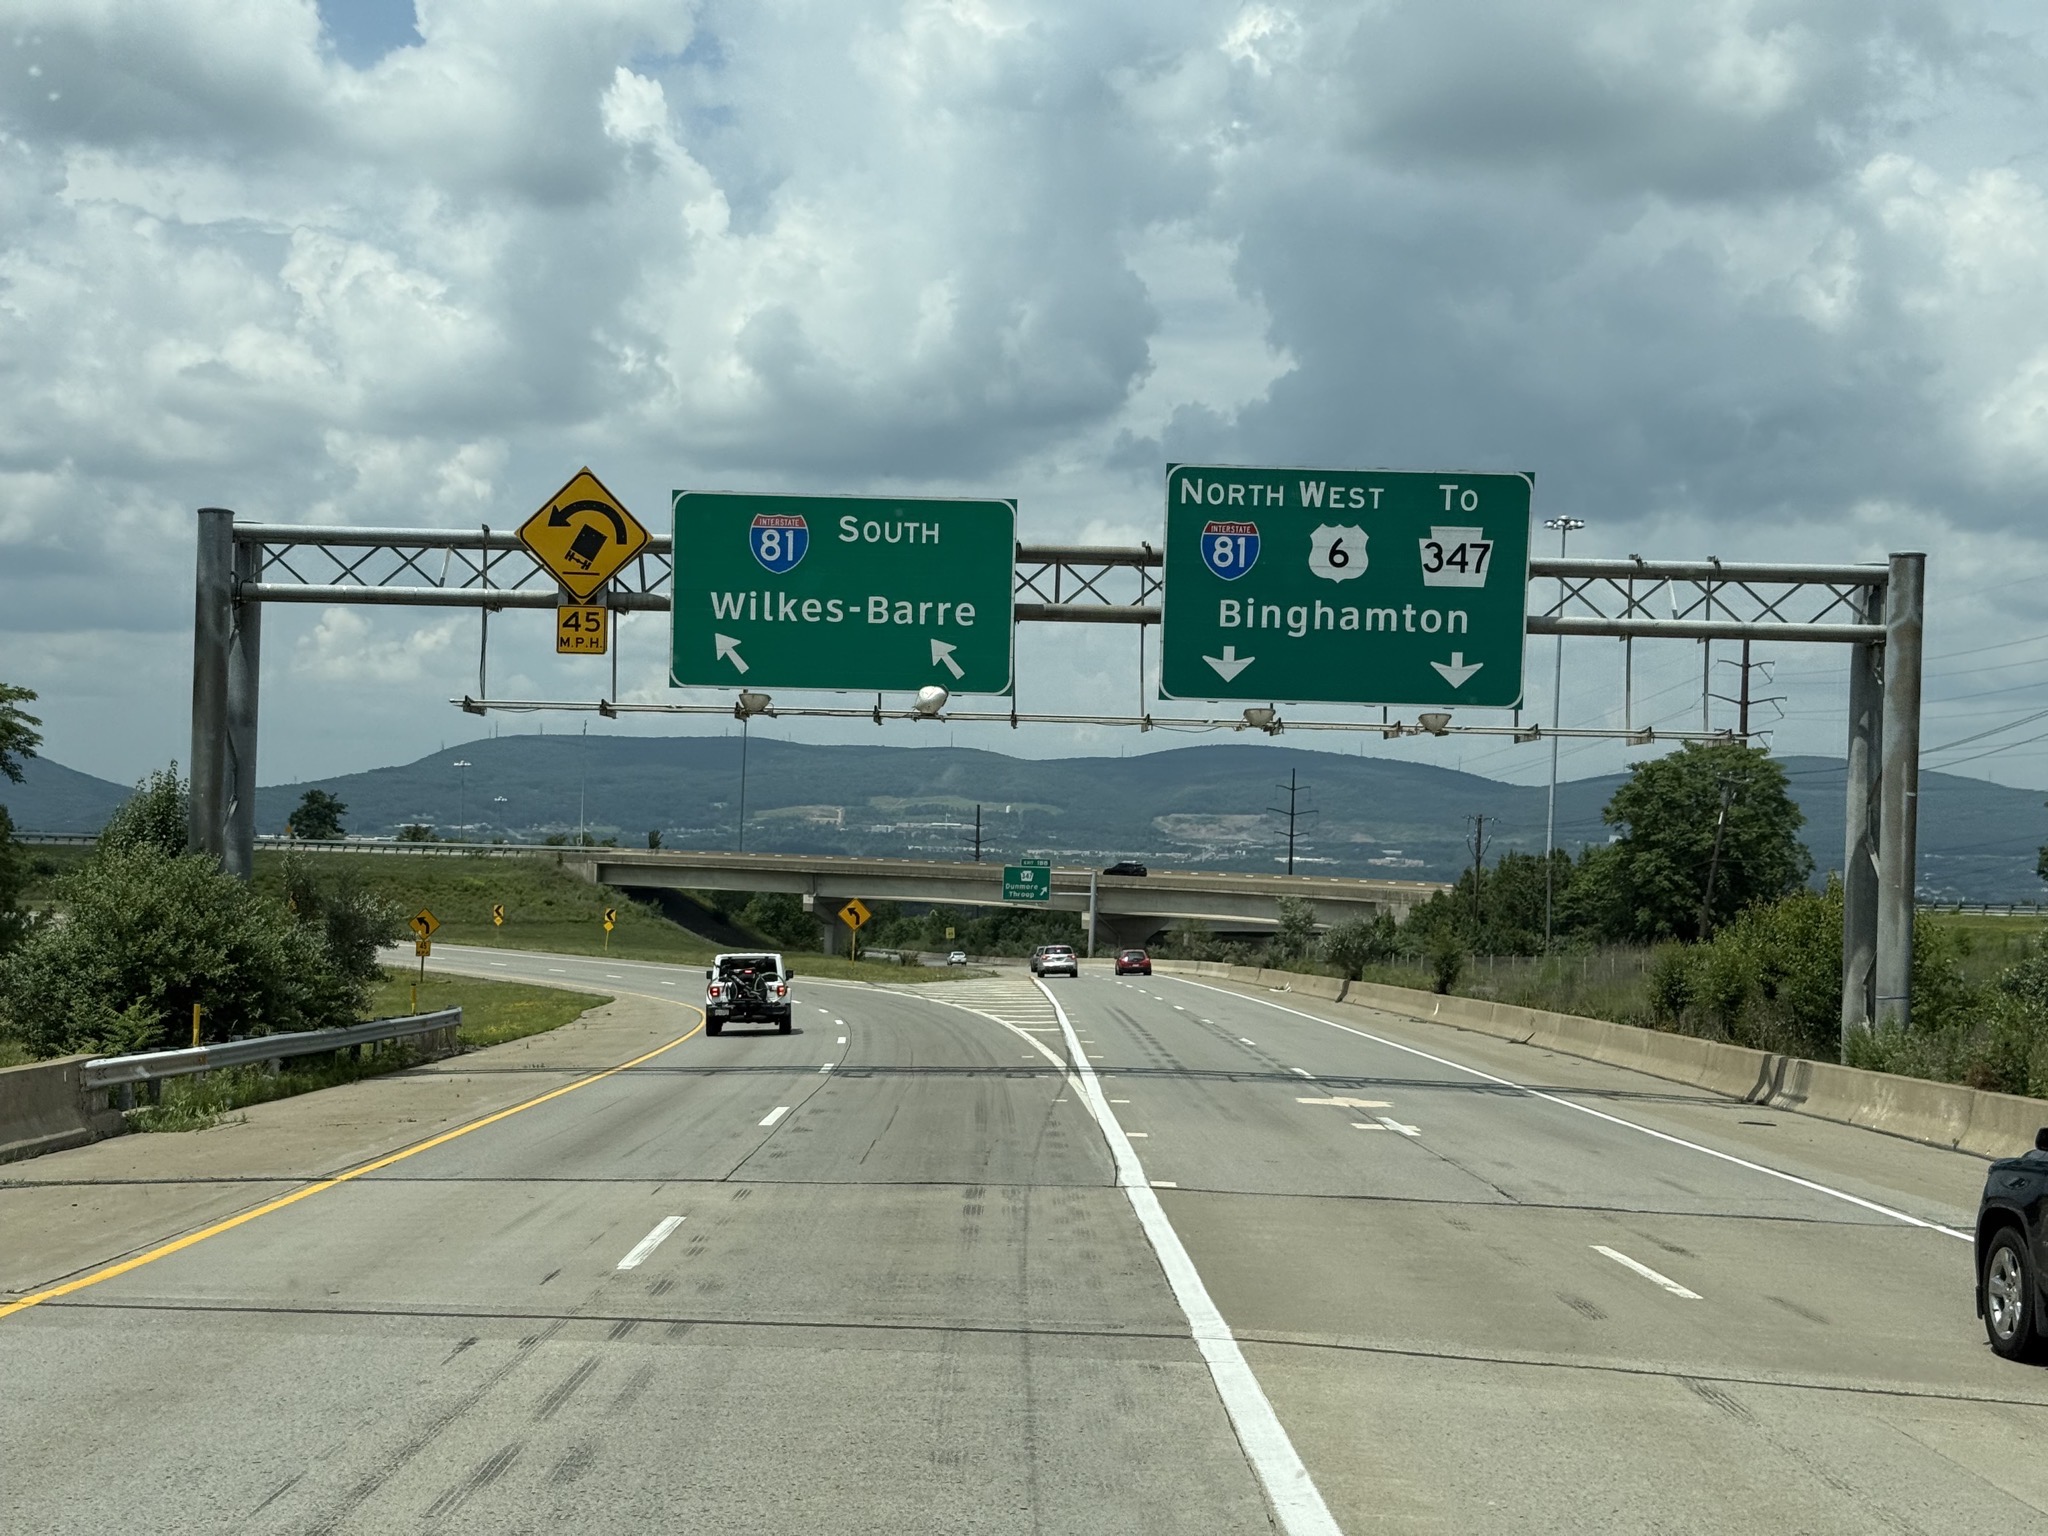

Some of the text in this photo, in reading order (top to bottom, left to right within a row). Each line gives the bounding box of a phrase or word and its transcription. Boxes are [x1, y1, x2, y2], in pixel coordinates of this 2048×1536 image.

[1180, 478, 1284, 507] NORTH
[1299, 480, 1385, 509] WEST
[759, 517, 800, 528] INTERSTATE
[838, 515, 940, 544] SOUTH
[1210, 524, 1251, 534] INTERSTATE
[759, 529, 794, 562] 81
[1212, 536, 1246, 568] 81
[1328, 537, 1350, 568] 6
[1423, 541, 1491, 575] 347
[562, 611, 601, 633] 45
[710, 591, 977, 627] Wilkes-Barre
[1219, 597, 1468, 637] Binghamton
[560, 637, 603, 648] M.P.H.
[1008, 891, 1035, 899] Throop
